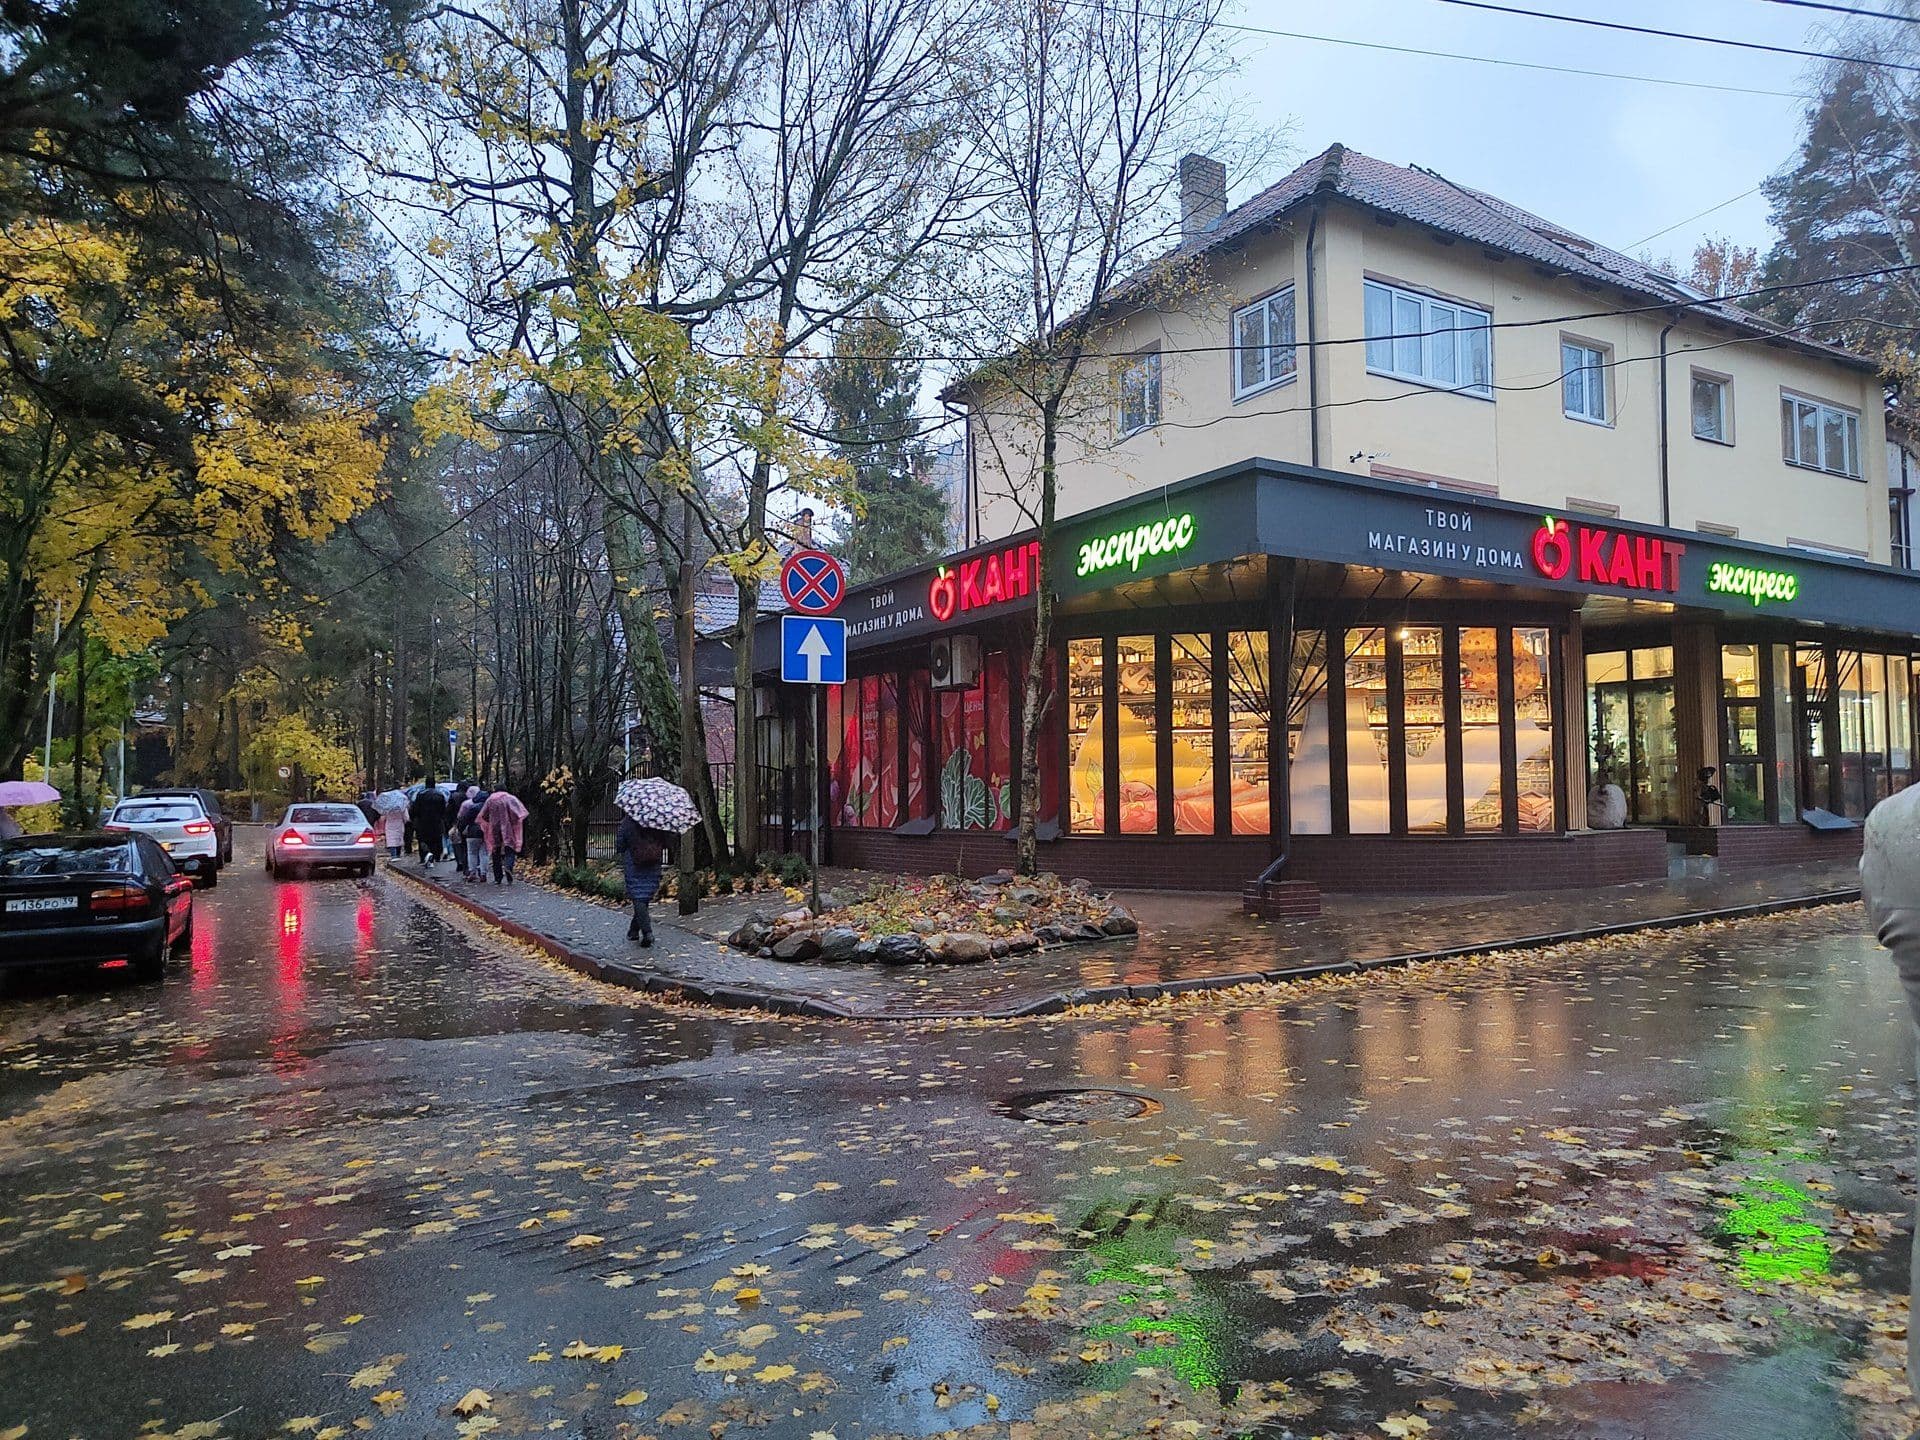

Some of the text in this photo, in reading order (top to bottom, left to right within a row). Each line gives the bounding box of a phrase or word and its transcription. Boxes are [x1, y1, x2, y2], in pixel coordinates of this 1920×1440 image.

[1425, 508, 1473, 532] ТВОЙ
[1076, 513, 1195, 577] экспресс
[1368, 531, 1524, 569] МАГАЗИН У ДОМА
[869, 588, 895, 610] ТВОЙ
[1708, 562, 1797, 607] экспресс
[887, 613, 894, 627] У
[895, 606, 924, 628] ДОМА
